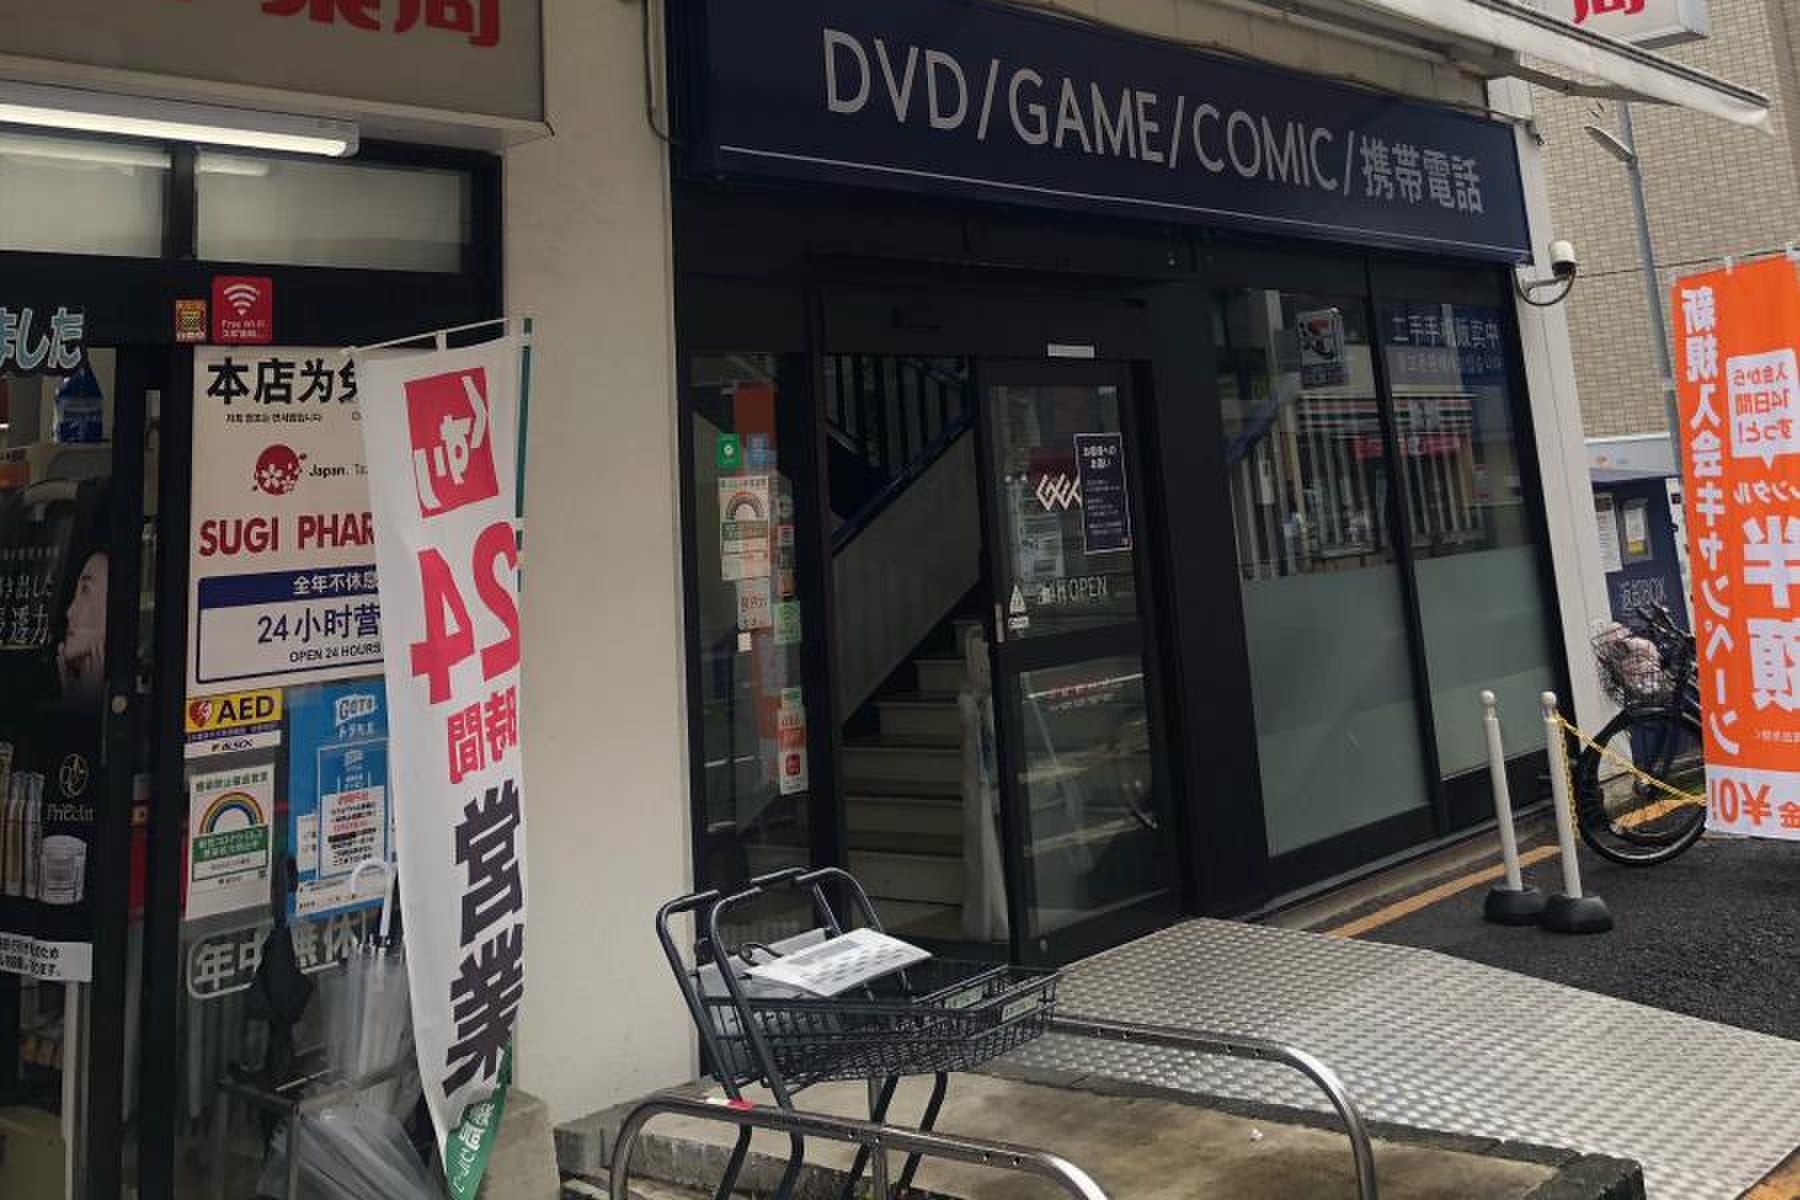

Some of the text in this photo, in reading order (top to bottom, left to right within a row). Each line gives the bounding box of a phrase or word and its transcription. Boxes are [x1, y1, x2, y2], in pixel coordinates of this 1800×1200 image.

[199, 517, 279, 557] SUGI
[289, 642, 381, 663] OPEN 24 HOURS
[217, 696, 274, 724] AED
